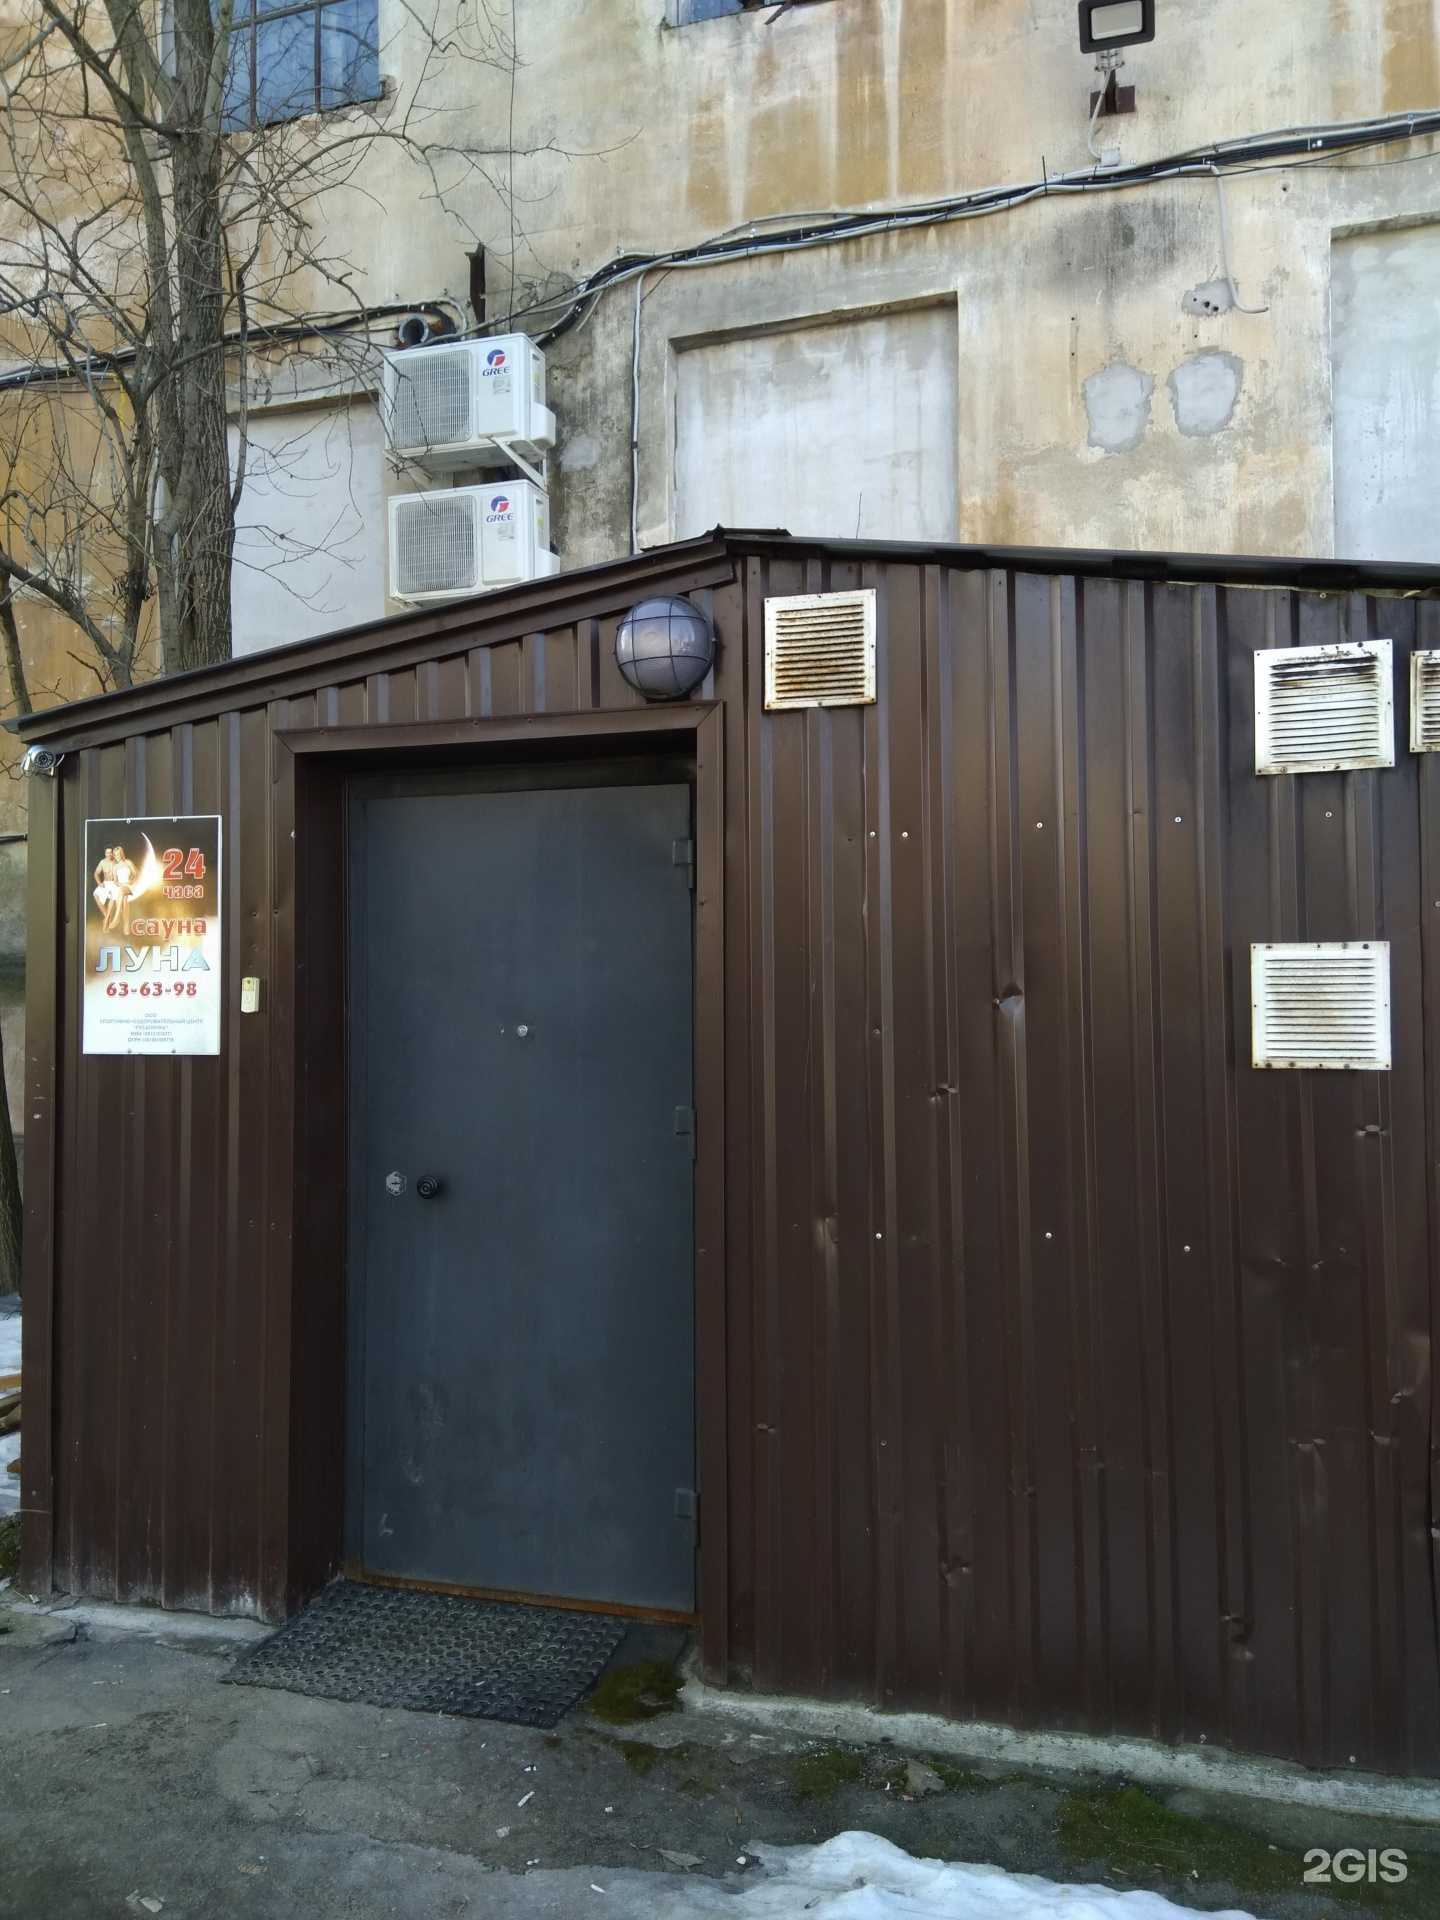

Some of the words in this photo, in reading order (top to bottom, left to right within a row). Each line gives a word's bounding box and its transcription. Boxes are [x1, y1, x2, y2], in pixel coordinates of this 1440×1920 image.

[482, 367, 511, 376] GREE
[486, 513, 513, 523] GREE
[162, 847, 206, 880] 24
[162, 884, 204, 899] часа
[131, 917, 207, 940] сауна
[95, 945, 210, 973] ЛУНА
[106, 981, 197, 997] 63-63-98
